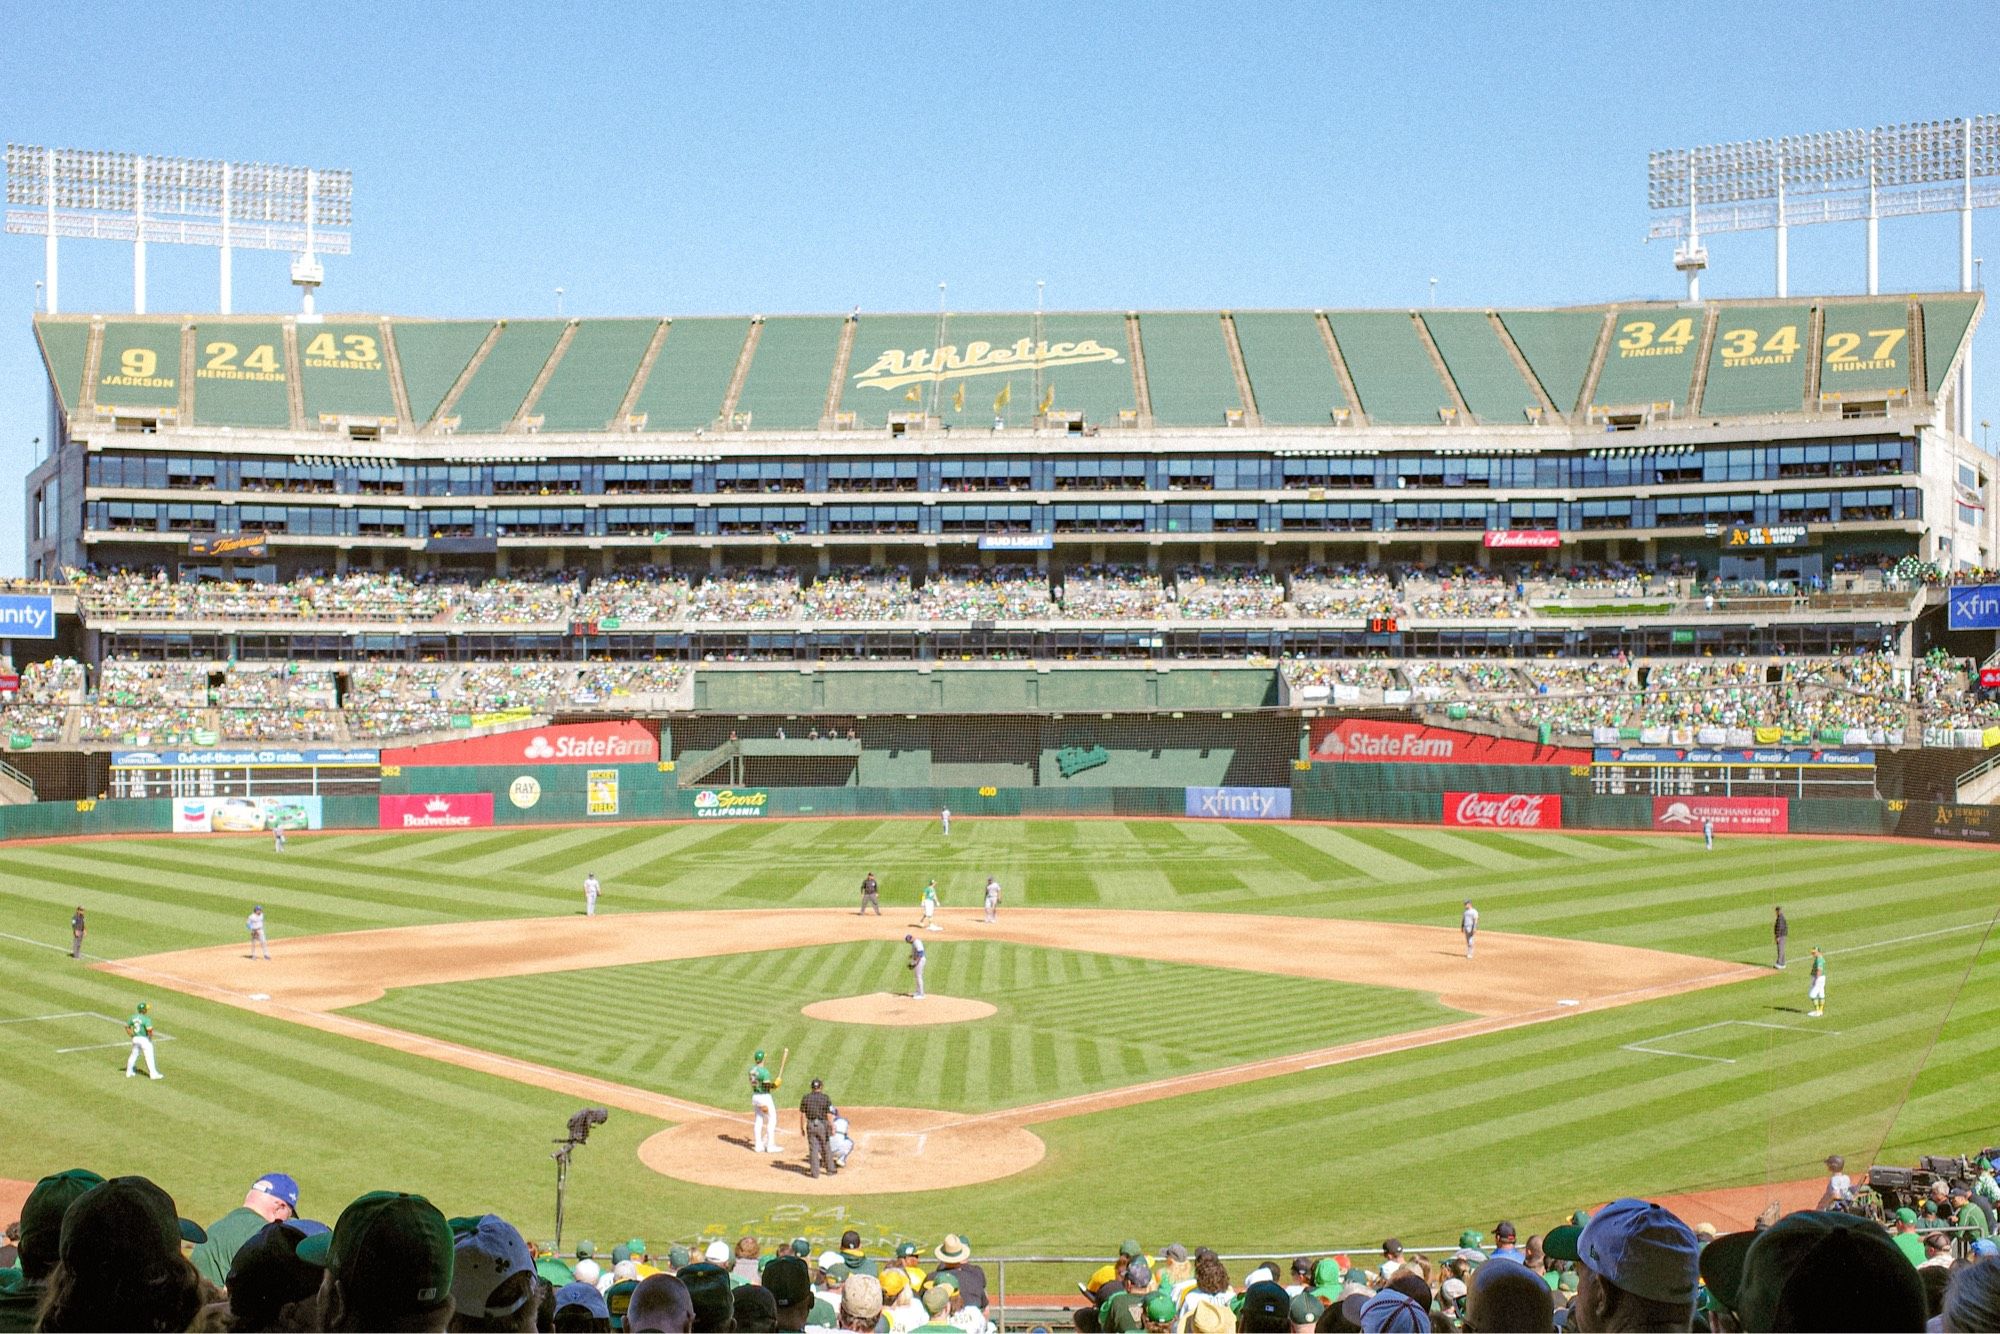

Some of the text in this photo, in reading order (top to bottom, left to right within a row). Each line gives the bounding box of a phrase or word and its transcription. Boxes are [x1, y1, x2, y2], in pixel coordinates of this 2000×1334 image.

[1618, 318, 1694, 349] 34
[306, 333, 379, 362] 43
[1721, 326, 1800, 357] 34
[1826, 329, 1906, 362] 27
[205, 342, 280, 373] 24
[1620, 345, 1685, 359] FINGERS
[121, 348, 157, 378] 9
[853, 337, 1119, 388] Athletics
[1724, 354, 1794, 368] STEWART
[1832, 358, 1896, 372] HUNTER
[102, 376, 174, 389] JACKSON
[196, 369, 285, 382] HENDERSON
[986, 536, 1010, 546] BUD
[1490, 532, 1557, 547] Budweiser
[259, 752, 275, 762] CD
[515, 782, 534, 794] RAY
[978, 786, 997, 797] 400
[717, 790, 766, 806] Sports
[1202, 790, 1275, 817] xfinity
[76, 800, 97, 812] 367
[697, 807, 760, 817] CALIFORNIA
[1753, 807, 1780, 817] GOLD
[403, 814, 471, 828] Budweiser
[770, 1204, 850, 1222] 24
